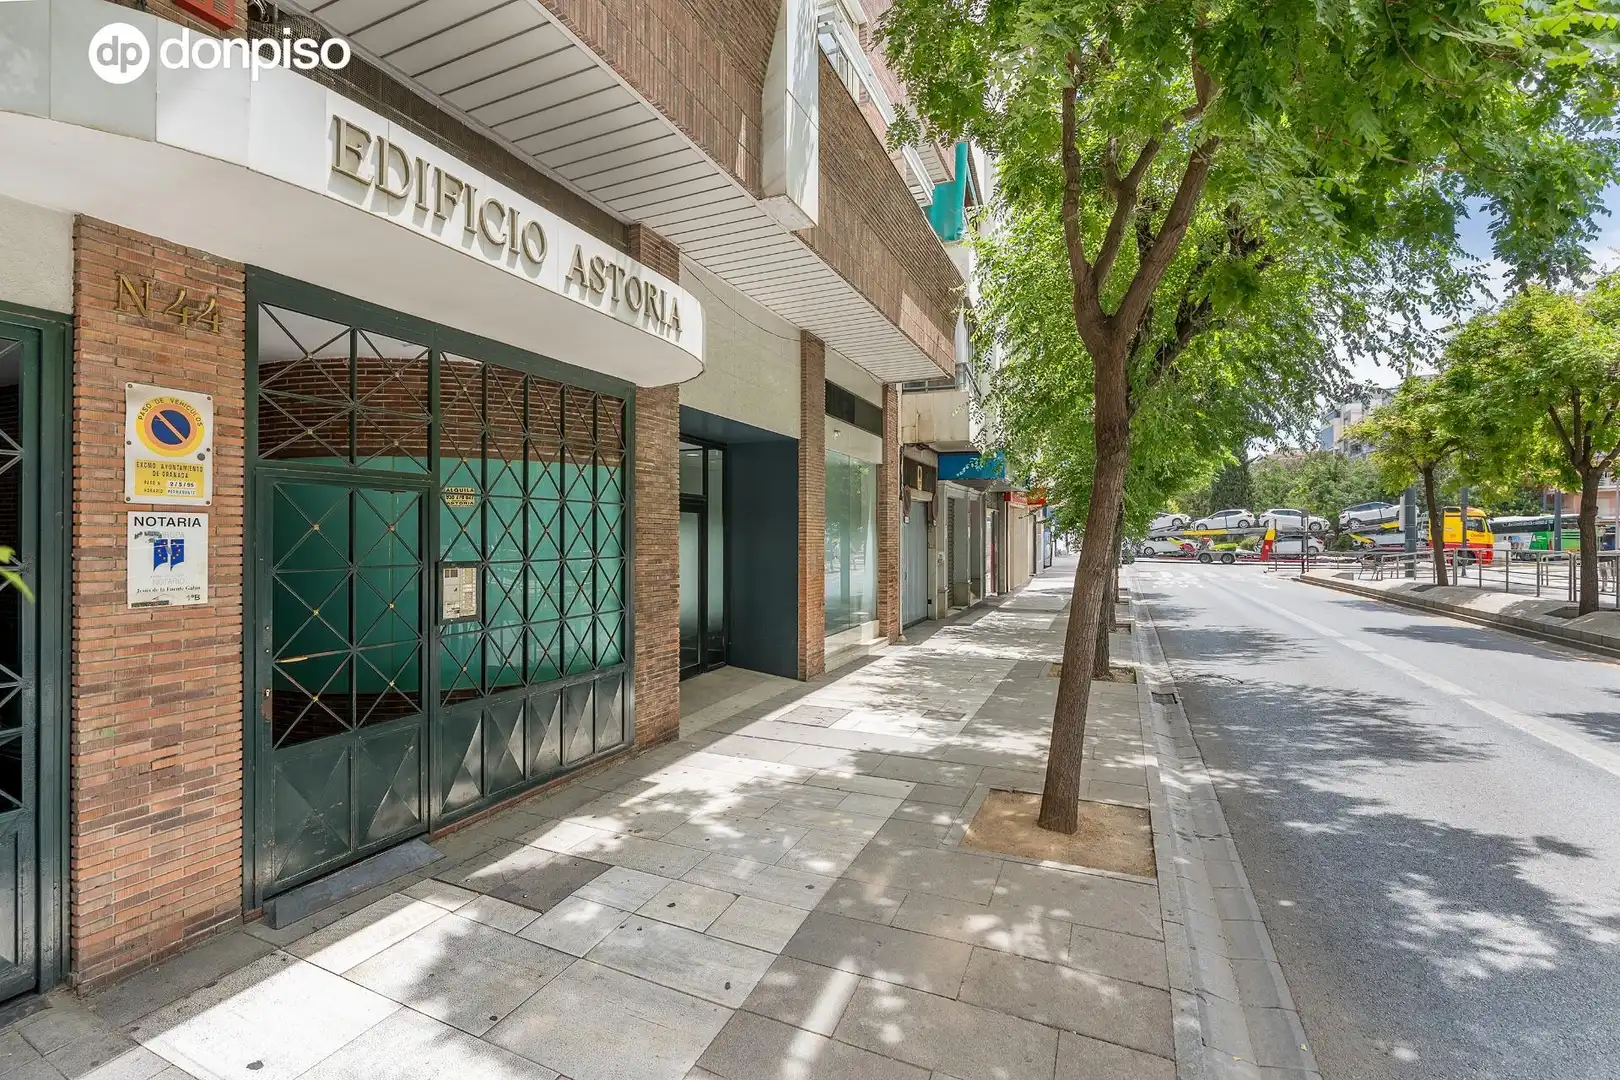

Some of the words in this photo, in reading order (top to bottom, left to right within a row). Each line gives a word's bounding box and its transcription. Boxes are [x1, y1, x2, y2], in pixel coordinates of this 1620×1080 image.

[331, 114, 549, 265] EDIFICIO
[565, 244, 683, 333] ASTORIA
[163, 287, 223, 334] 44
[137, 403, 153, 421] PASO
[154, 397, 165, 405] DE
[170, 398, 204, 427] VEHICULOS
[160, 463, 204, 473] AYUNTAMIENTO
[162, 471, 189, 479] GRANADA
[134, 516, 202, 528] NOTARIA
